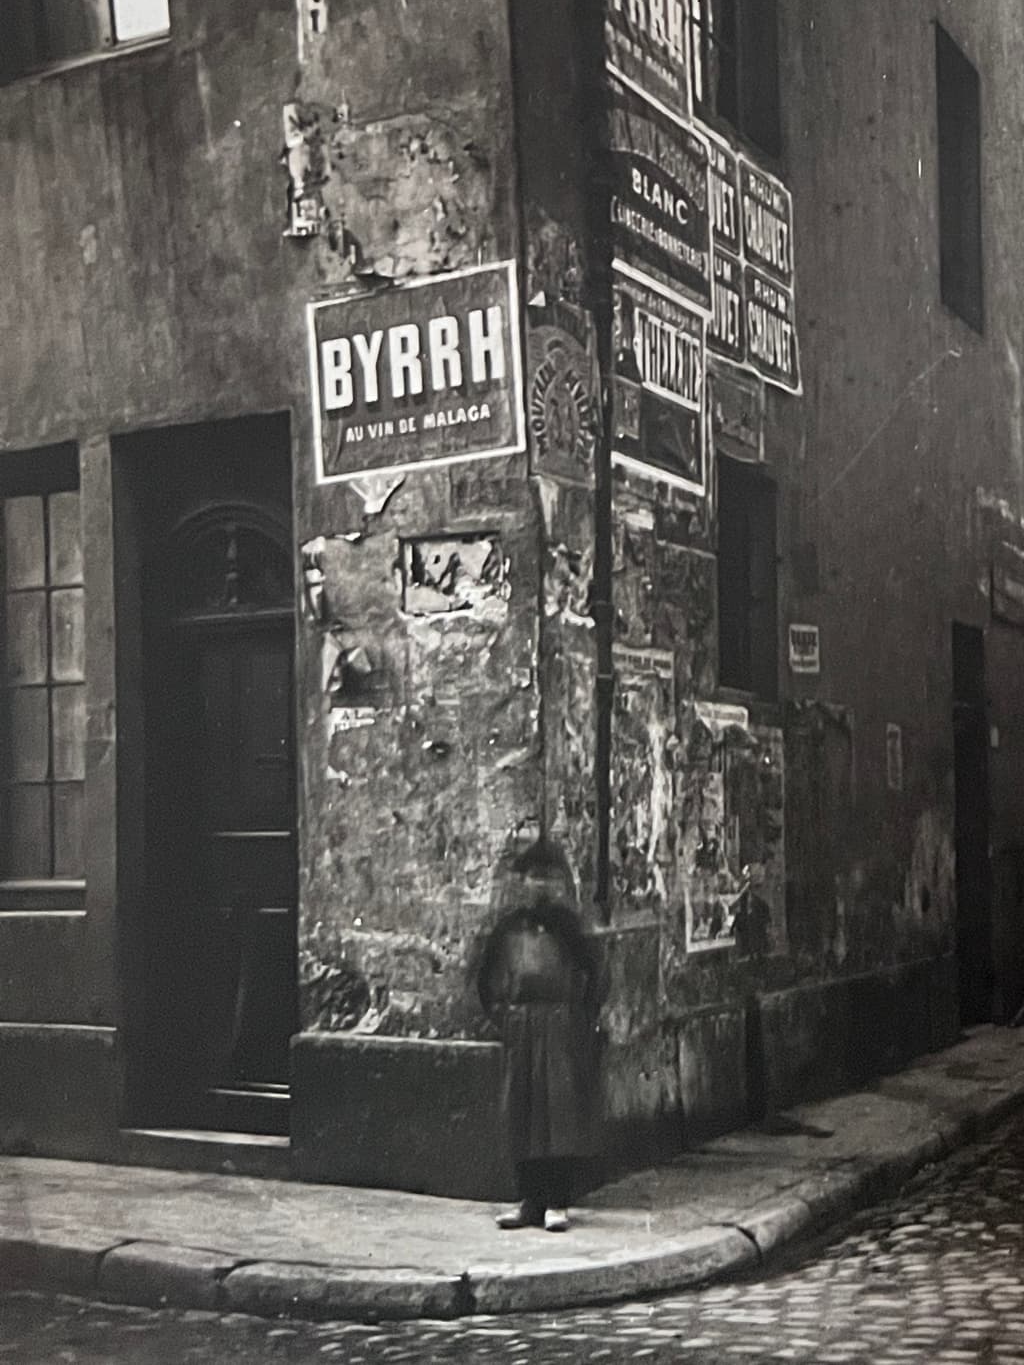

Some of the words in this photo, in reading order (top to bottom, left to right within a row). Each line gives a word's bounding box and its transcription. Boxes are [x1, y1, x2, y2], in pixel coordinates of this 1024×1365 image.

[631, 166, 689, 225] BLANC
[748, 173, 785, 214] RHUM
[714, 255, 733, 283] UM
[753, 278, 787, 314] RHUM
[321, 305, 506, 411] BYRRH
[346, 426, 364, 443] AU
[367, 421, 394, 439] VIN
[398, 418, 417, 435] DE
[423, 403, 491, 430] MALAGA
